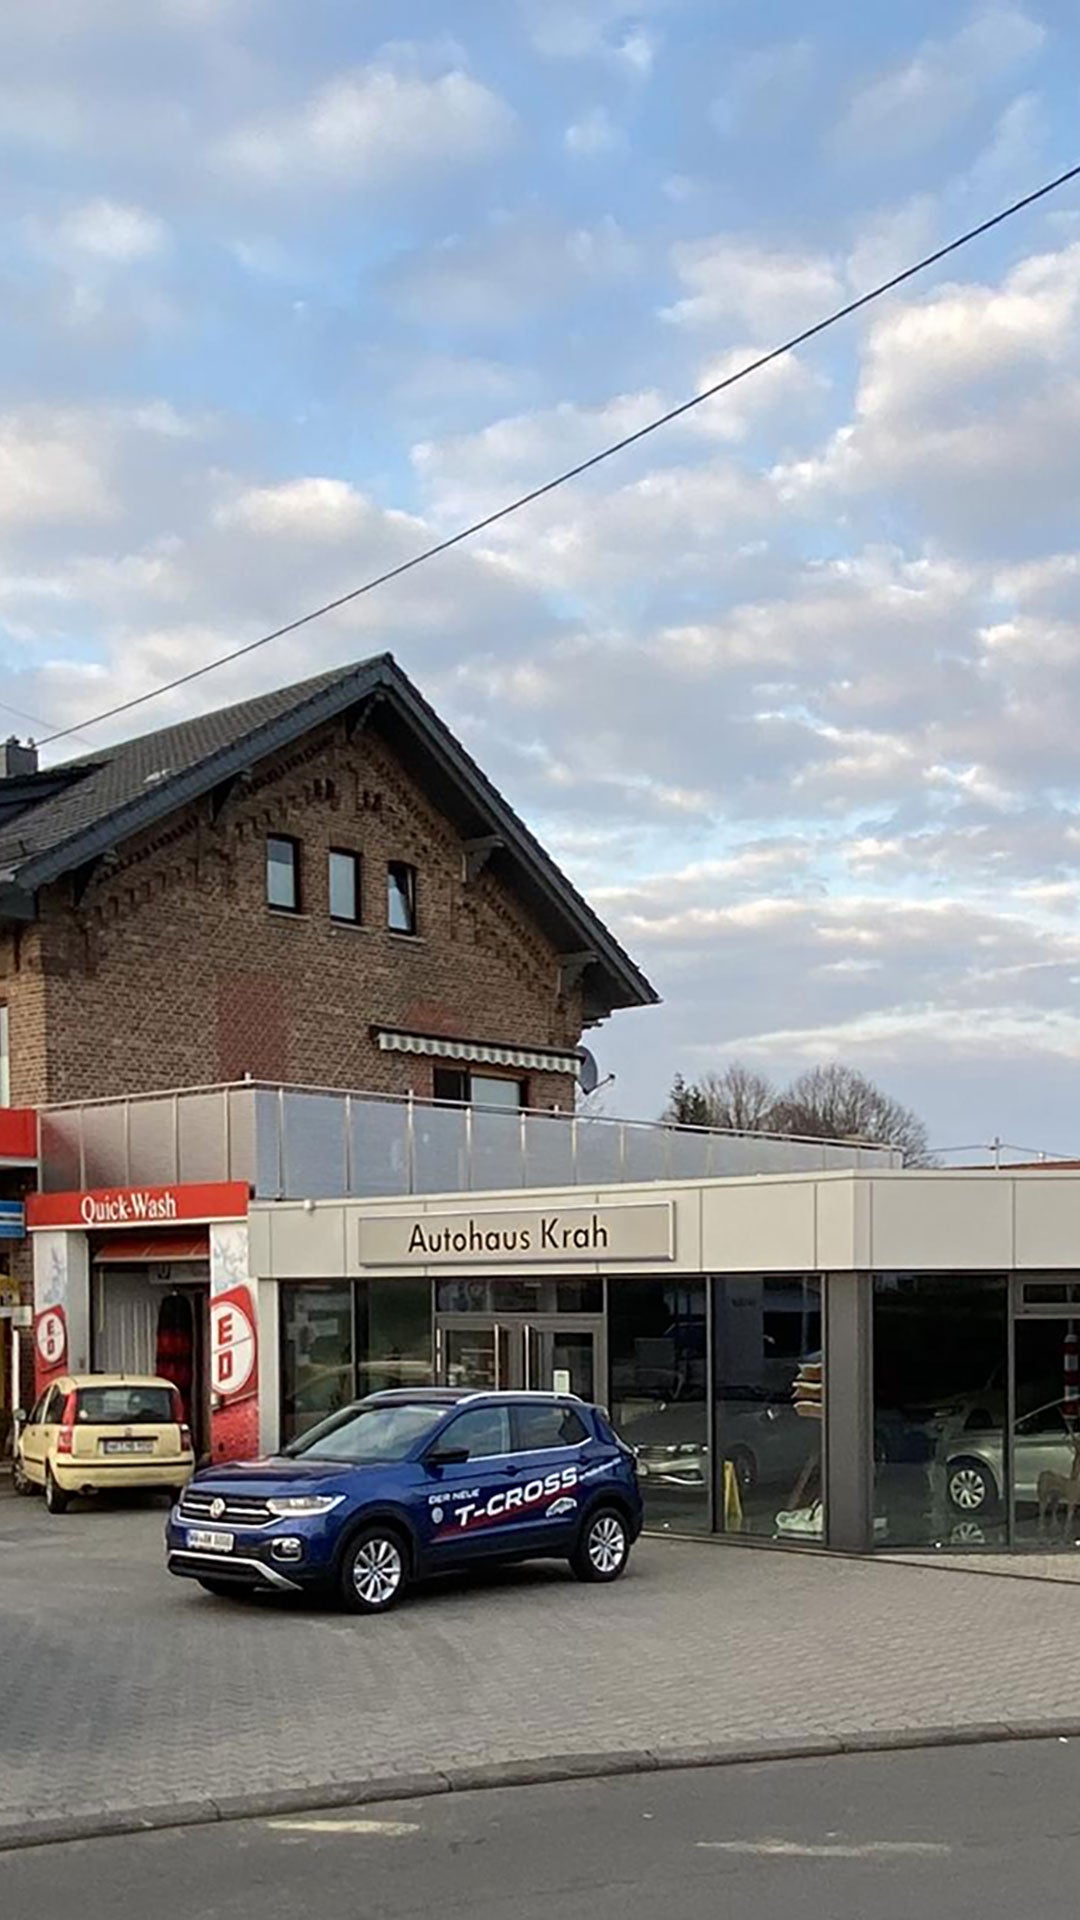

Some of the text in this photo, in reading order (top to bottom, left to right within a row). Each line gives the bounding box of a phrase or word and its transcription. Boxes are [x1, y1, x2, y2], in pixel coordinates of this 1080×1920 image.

[408, 1214, 608, 1252] Autohaus Krah
[428, 1493, 450, 1505] DER
[454, 1467, 577, 1527] T-CROSS
